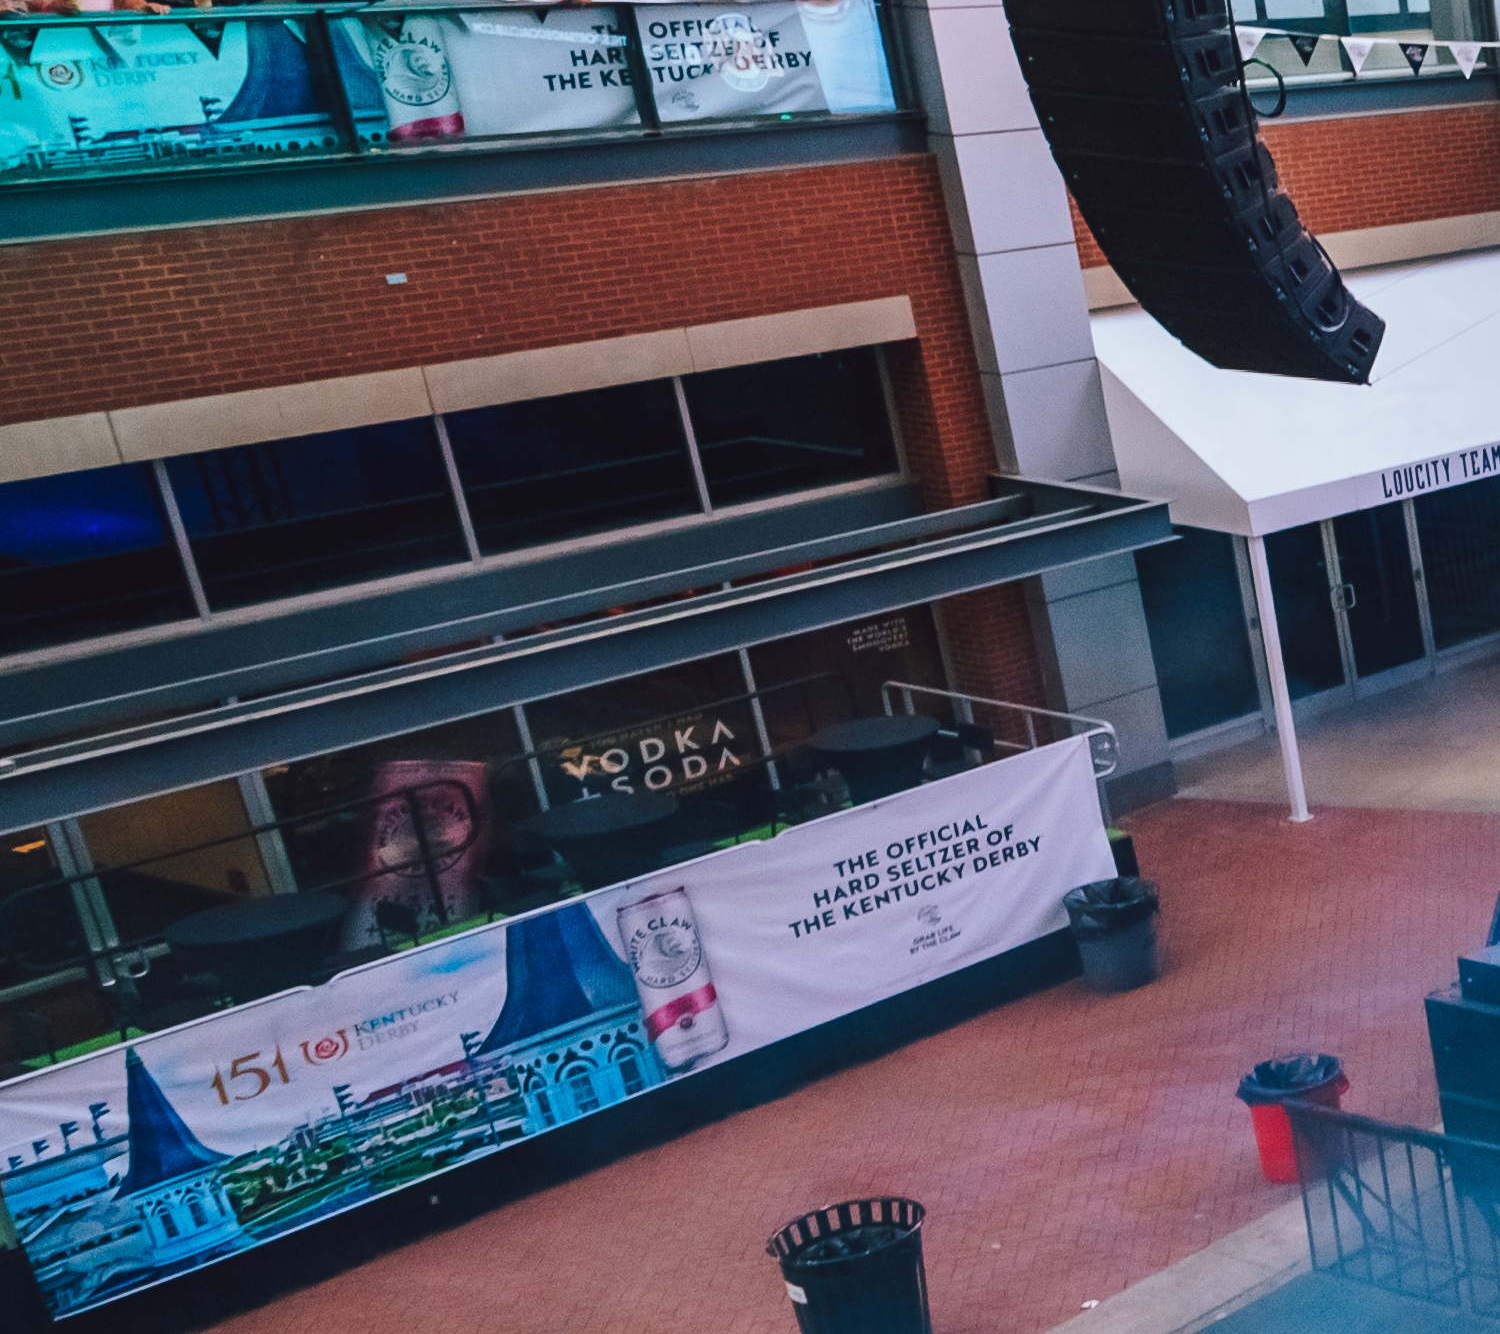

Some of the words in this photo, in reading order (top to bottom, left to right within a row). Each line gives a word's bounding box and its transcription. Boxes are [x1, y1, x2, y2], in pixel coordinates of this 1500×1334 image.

[543, 72, 593, 92] THE
[570, 47, 624, 67] HAR
[1381, 457, 1450, 499] LOUCITY
[560, 720, 735, 781] VODKA
[813, 873, 880, 908] HARD
[886, 838, 980, 882] SELTZER
[986, 824, 1014, 846] OF
[833, 850, 880, 877] THE
[886, 814, 988, 860] OFFICIAL
[788, 910, 836, 939] THE
[843, 863, 965, 920] KENTUCKY
[973, 836, 1041, 873] DERBY
[629, 928, 646, 974] WHITE
[647, 916, 691, 931] CLAW
[354, 990, 459, 1037] KENTUCKY
[357, 1020, 420, 1051] DERBY
[211, 1041, 290, 1106] 151
